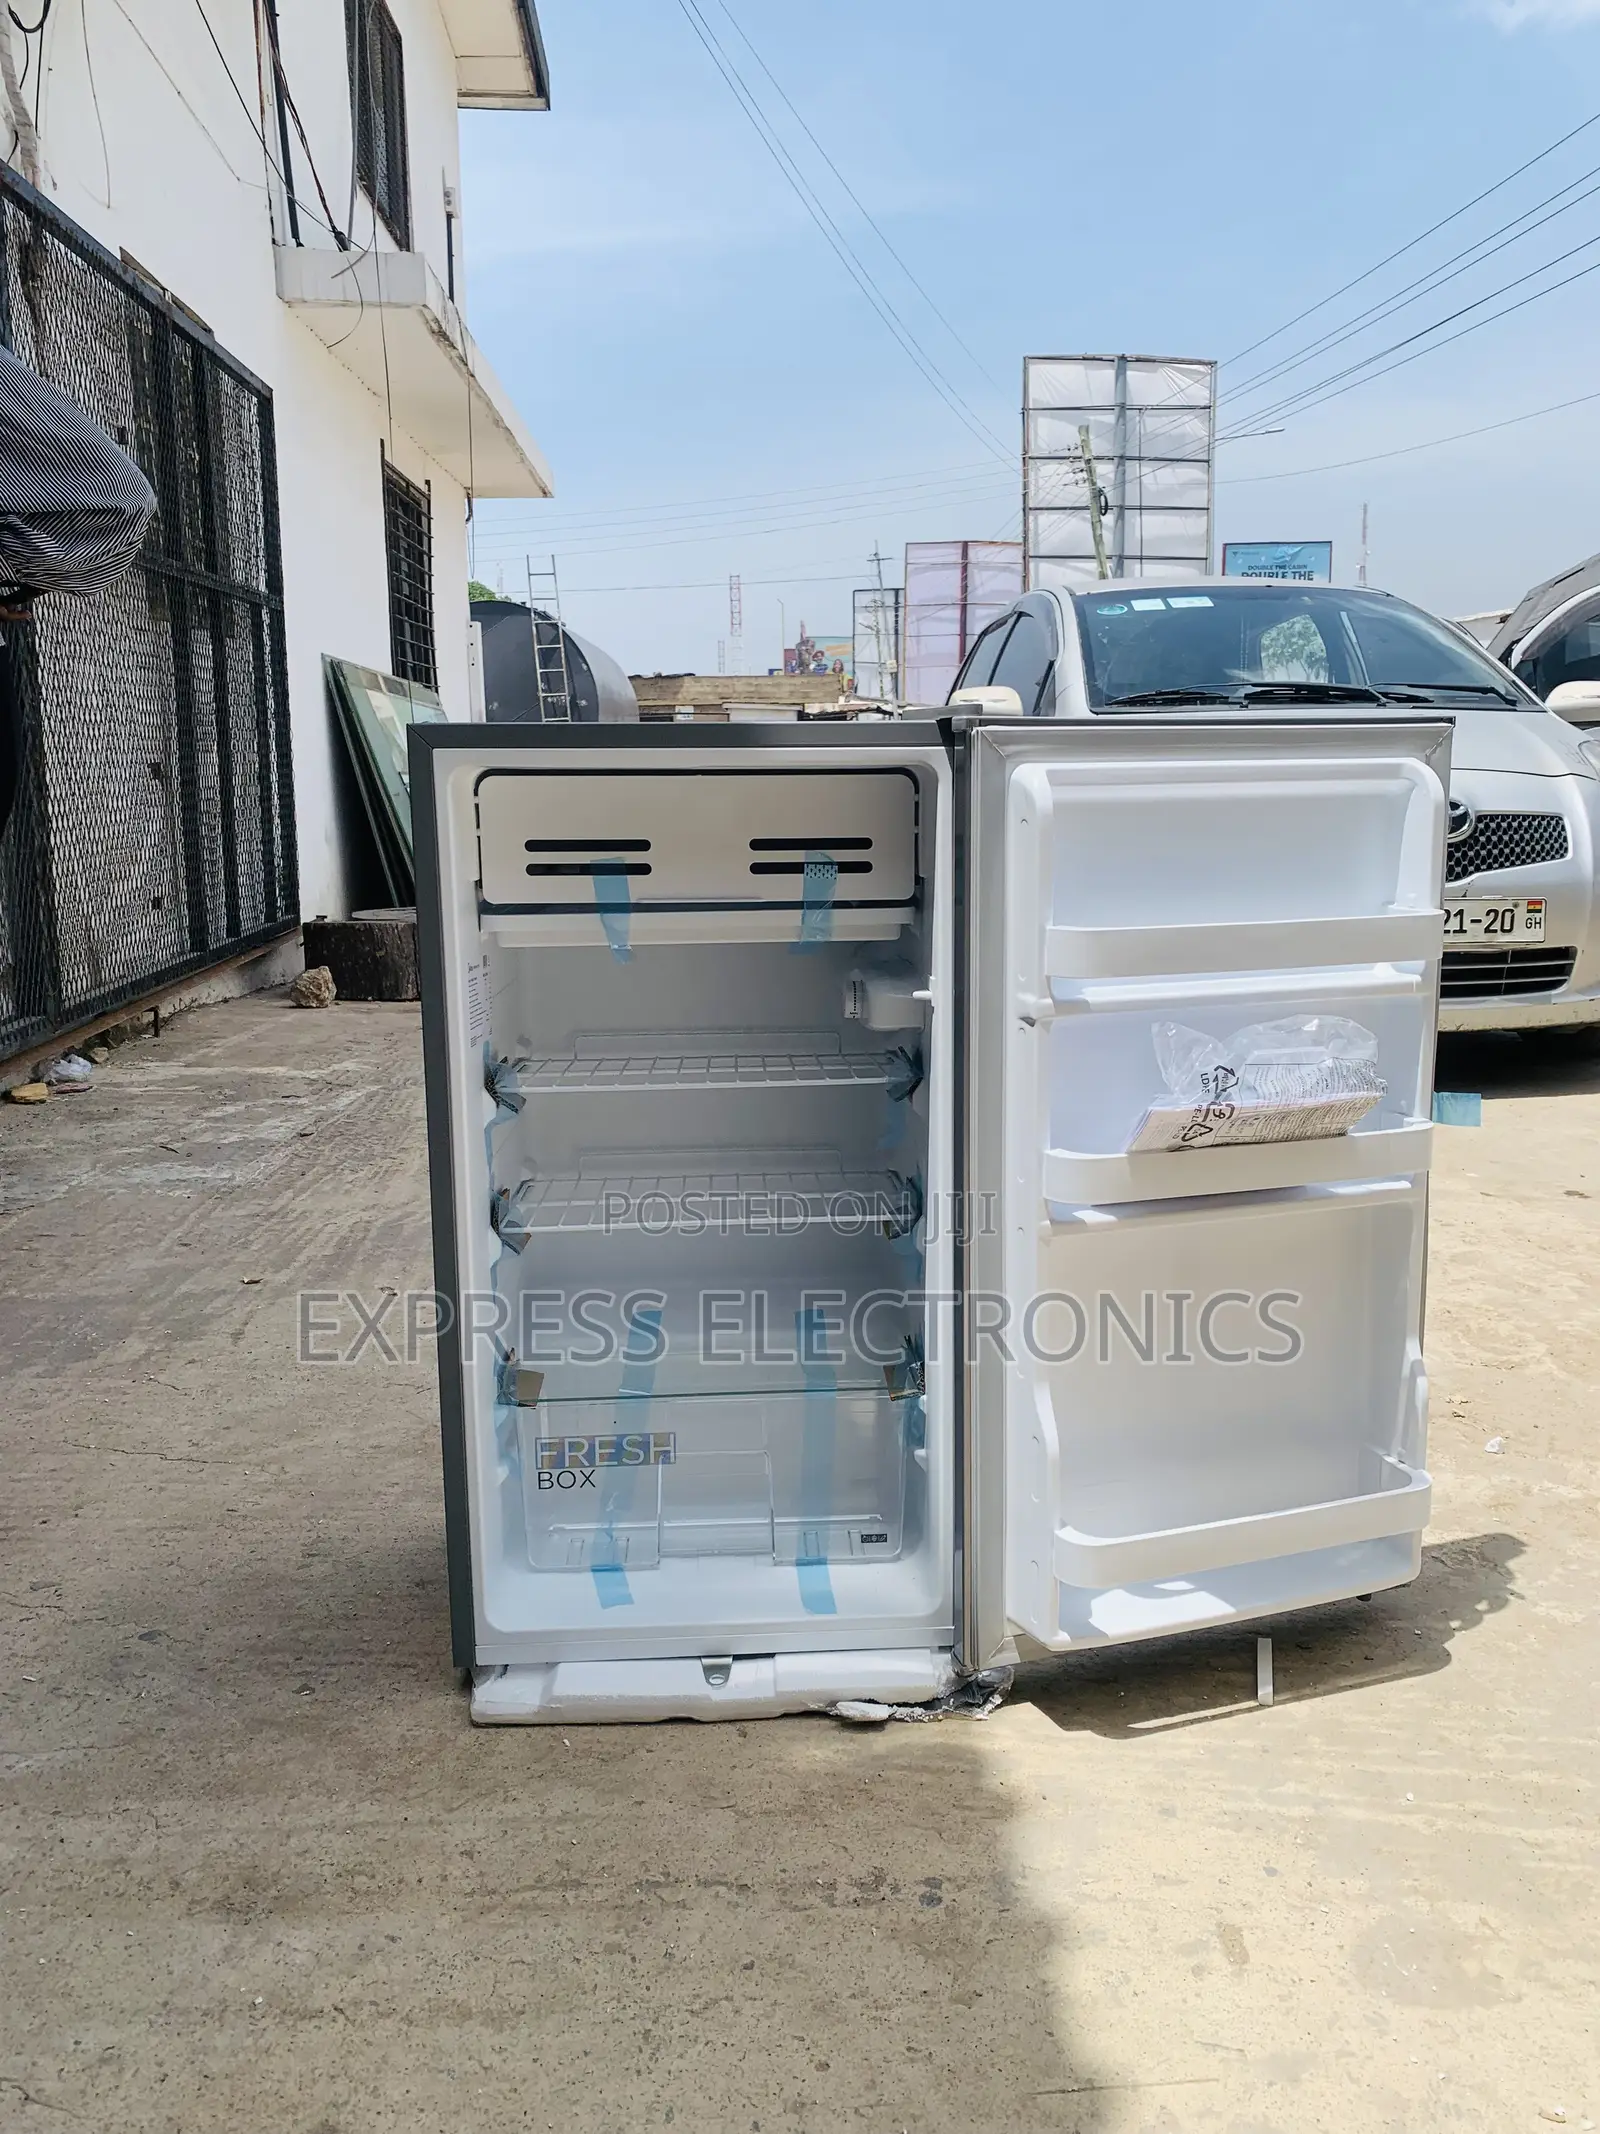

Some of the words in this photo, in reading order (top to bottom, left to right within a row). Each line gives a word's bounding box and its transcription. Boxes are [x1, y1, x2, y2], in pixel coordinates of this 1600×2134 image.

[1291, 570, 1314, 581] THE
[1525, 917, 1542, 930] GH
[535, 1433, 676, 1469] FRESH
[537, 1469, 596, 1490] BOX
